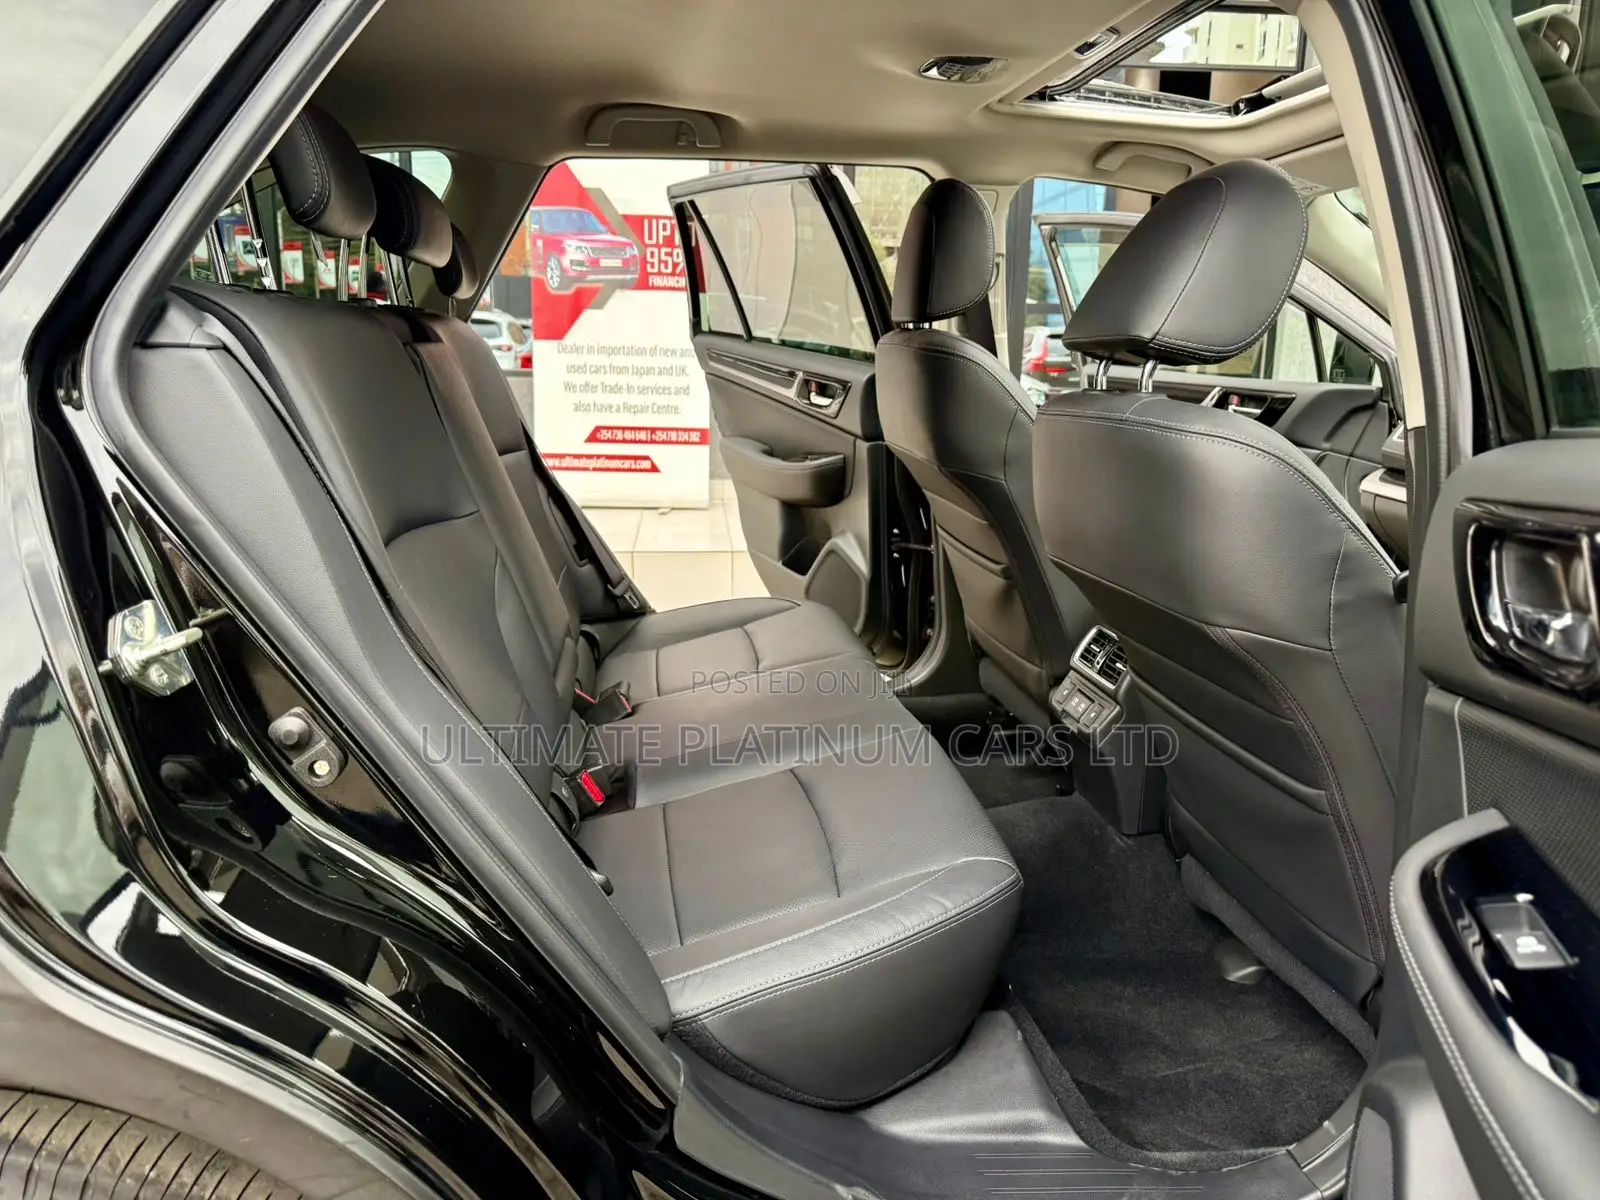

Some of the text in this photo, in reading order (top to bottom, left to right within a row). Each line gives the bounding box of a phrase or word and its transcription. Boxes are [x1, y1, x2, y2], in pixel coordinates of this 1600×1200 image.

[557, 342, 584, 355] Dealer
[587, 343, 595, 355] in
[597, 343, 647, 359] importation
[649, 344, 658, 357] of
[659, 346, 677, 358] new
[566, 361, 689, 379] used cars from Japan and UK.
[564, 381, 690, 396] We offer Trade-In services and
[573, 400, 681, 416] also have a Repair Centre.
